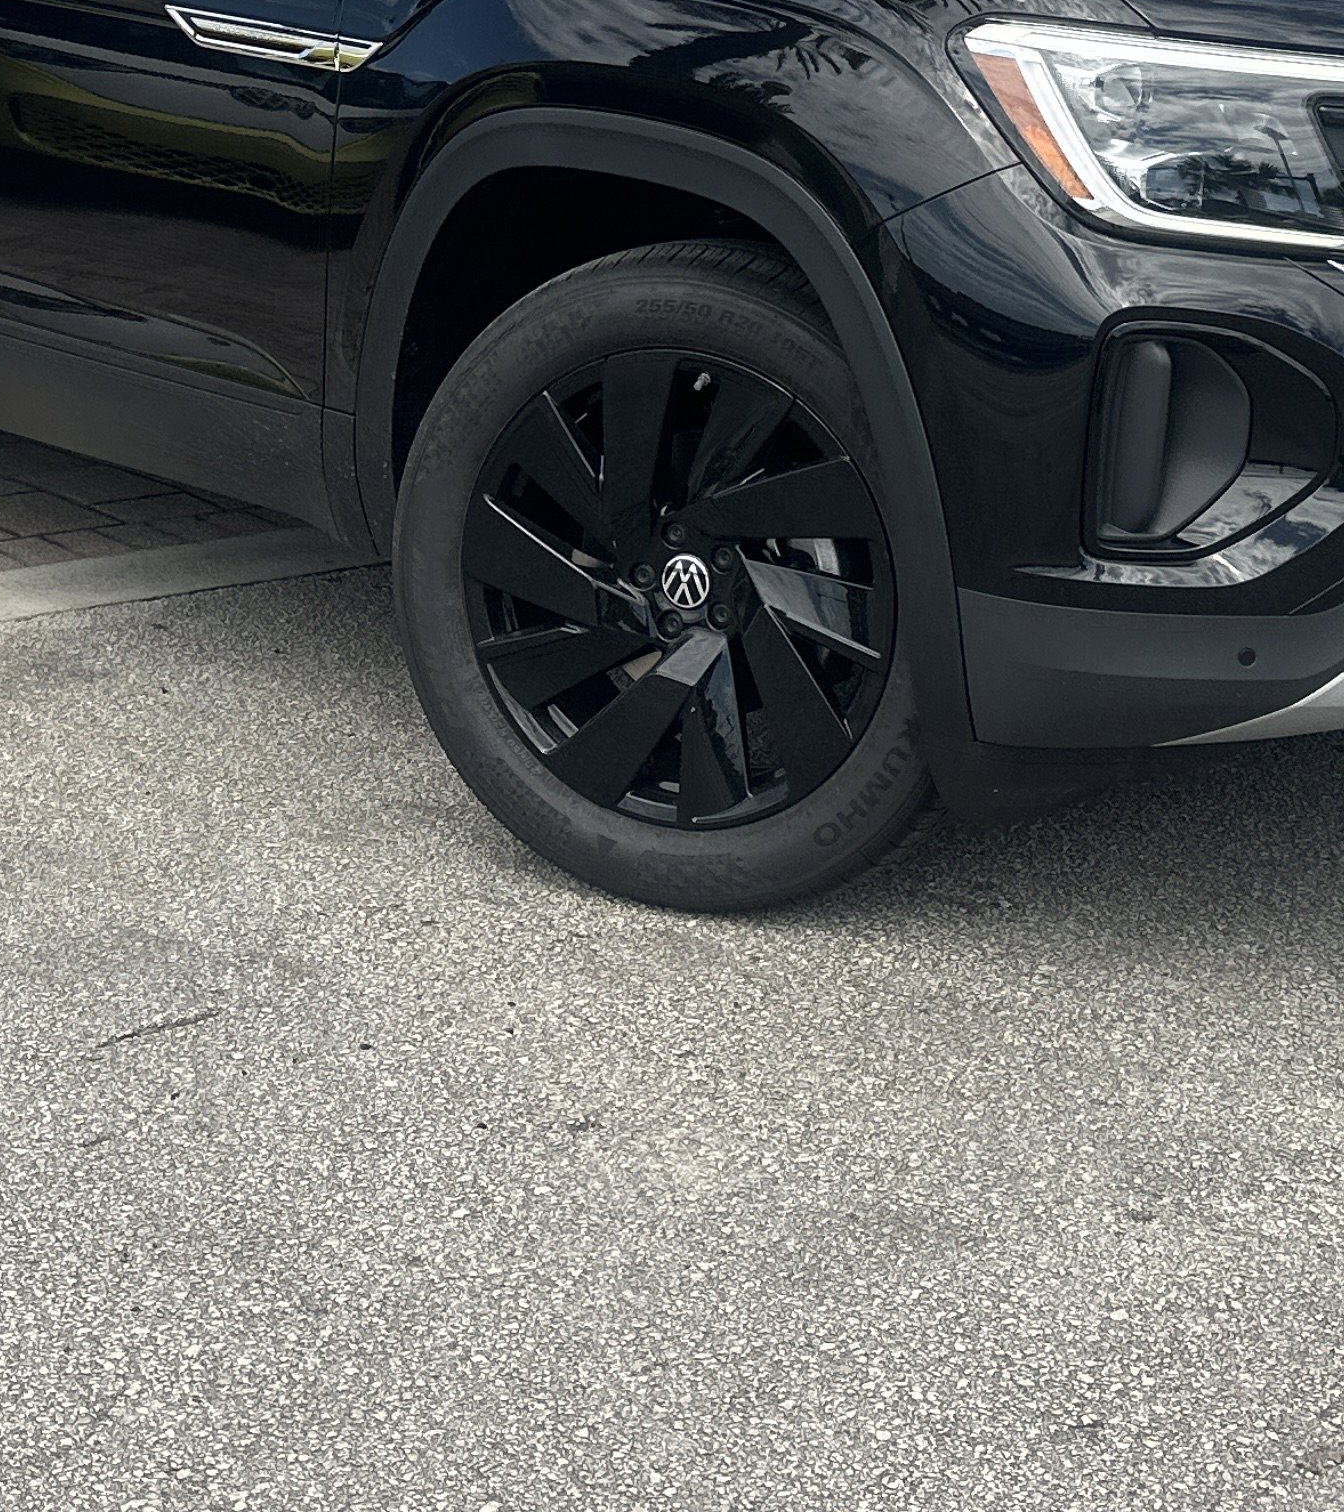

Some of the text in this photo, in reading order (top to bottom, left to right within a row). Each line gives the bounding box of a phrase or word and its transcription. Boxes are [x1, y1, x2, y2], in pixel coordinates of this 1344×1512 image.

[635, 299, 713, 322] 255/50
[718, 310, 764, 335] R20
[661, 554, 710, 609] VW
